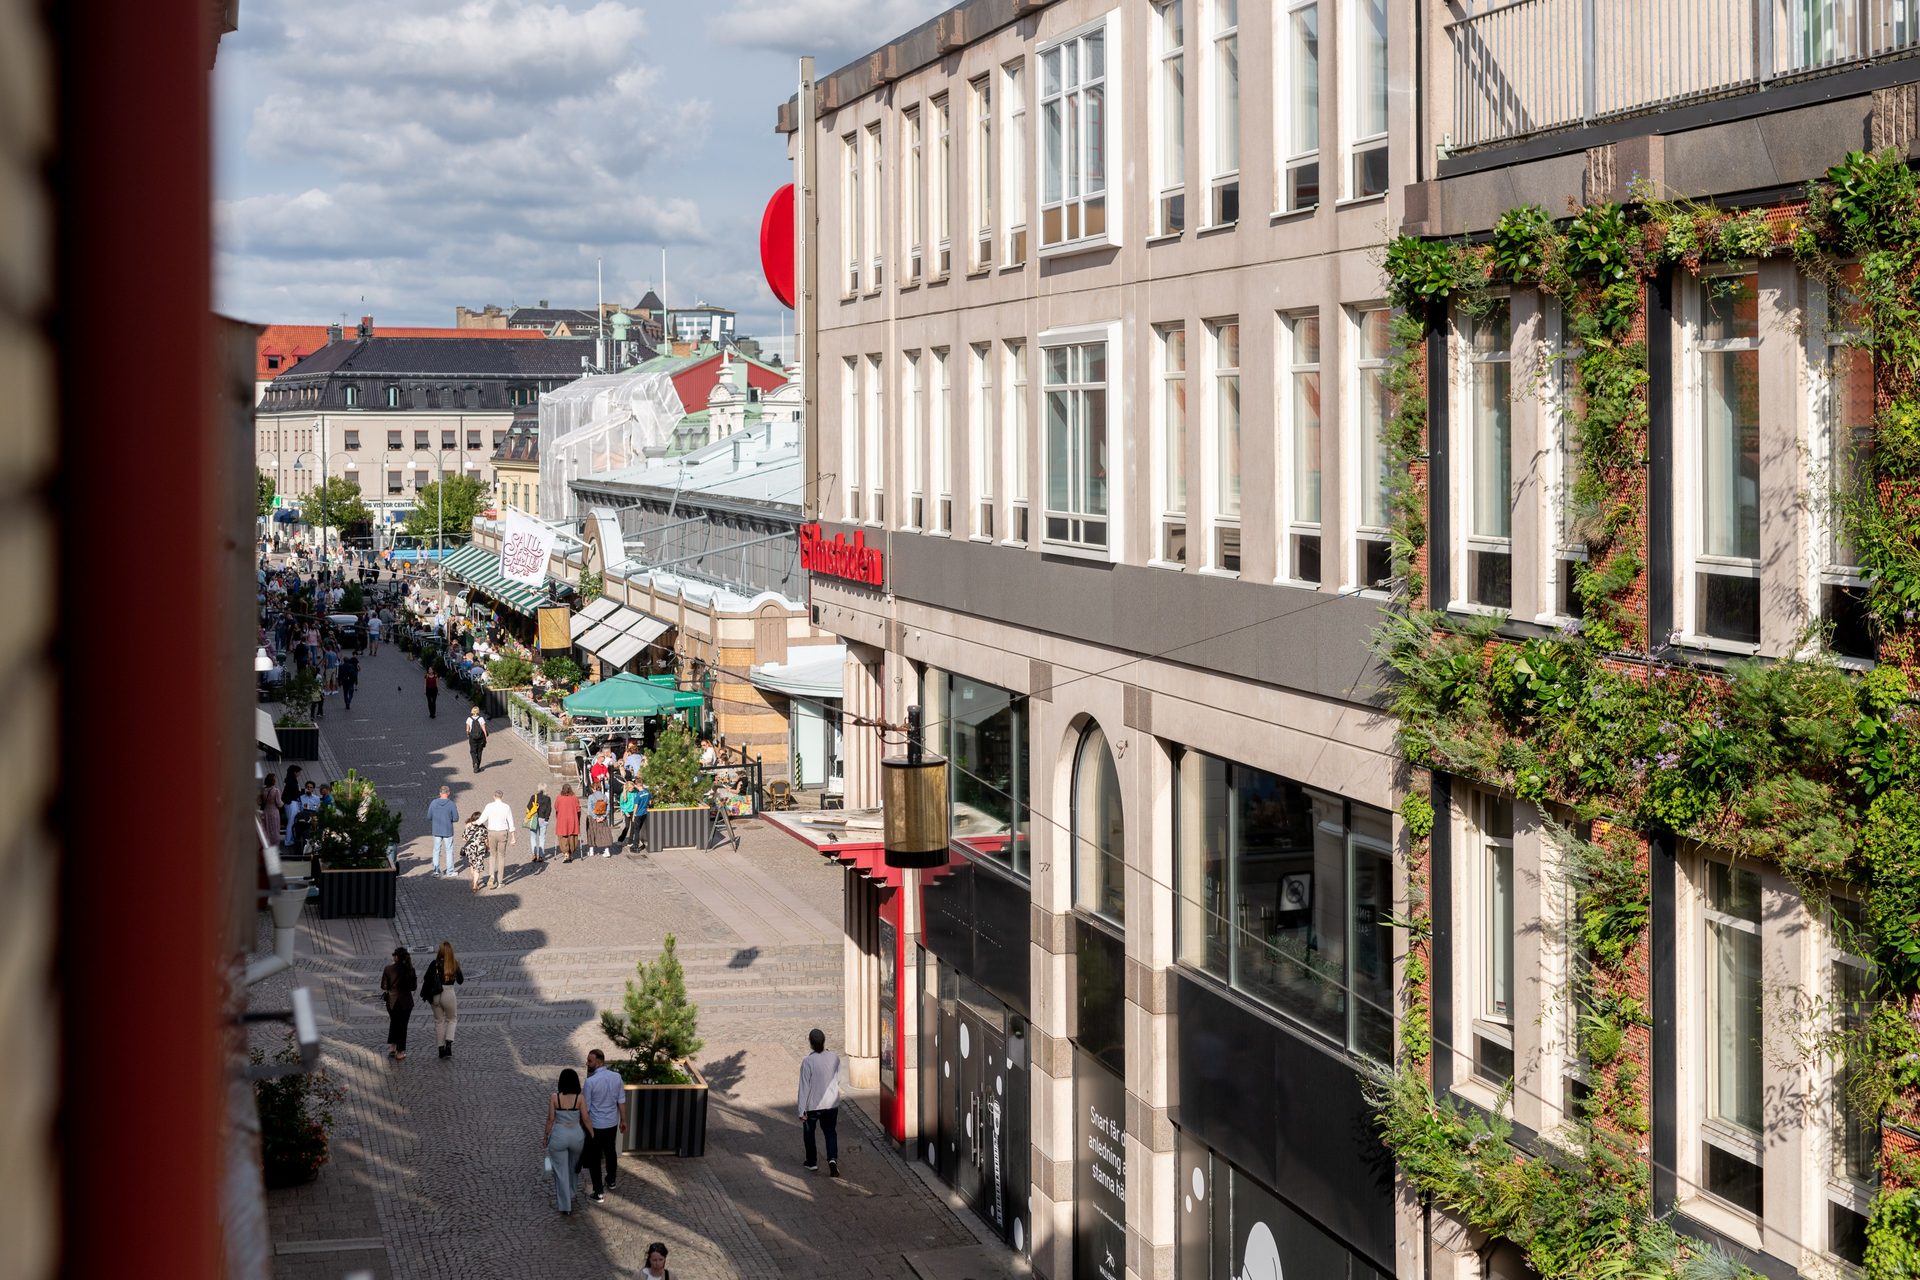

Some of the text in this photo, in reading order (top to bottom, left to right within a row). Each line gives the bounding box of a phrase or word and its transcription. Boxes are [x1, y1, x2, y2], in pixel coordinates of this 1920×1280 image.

[800, 523, 882, 585] Filmstaden
[1090, 1105, 1126, 1147] Snart får d
[1088, 1134, 1122, 1176] anledning
[1092, 1162, 1115, 1195] stanna
[1115, 1179, 1125, 1202] hä
